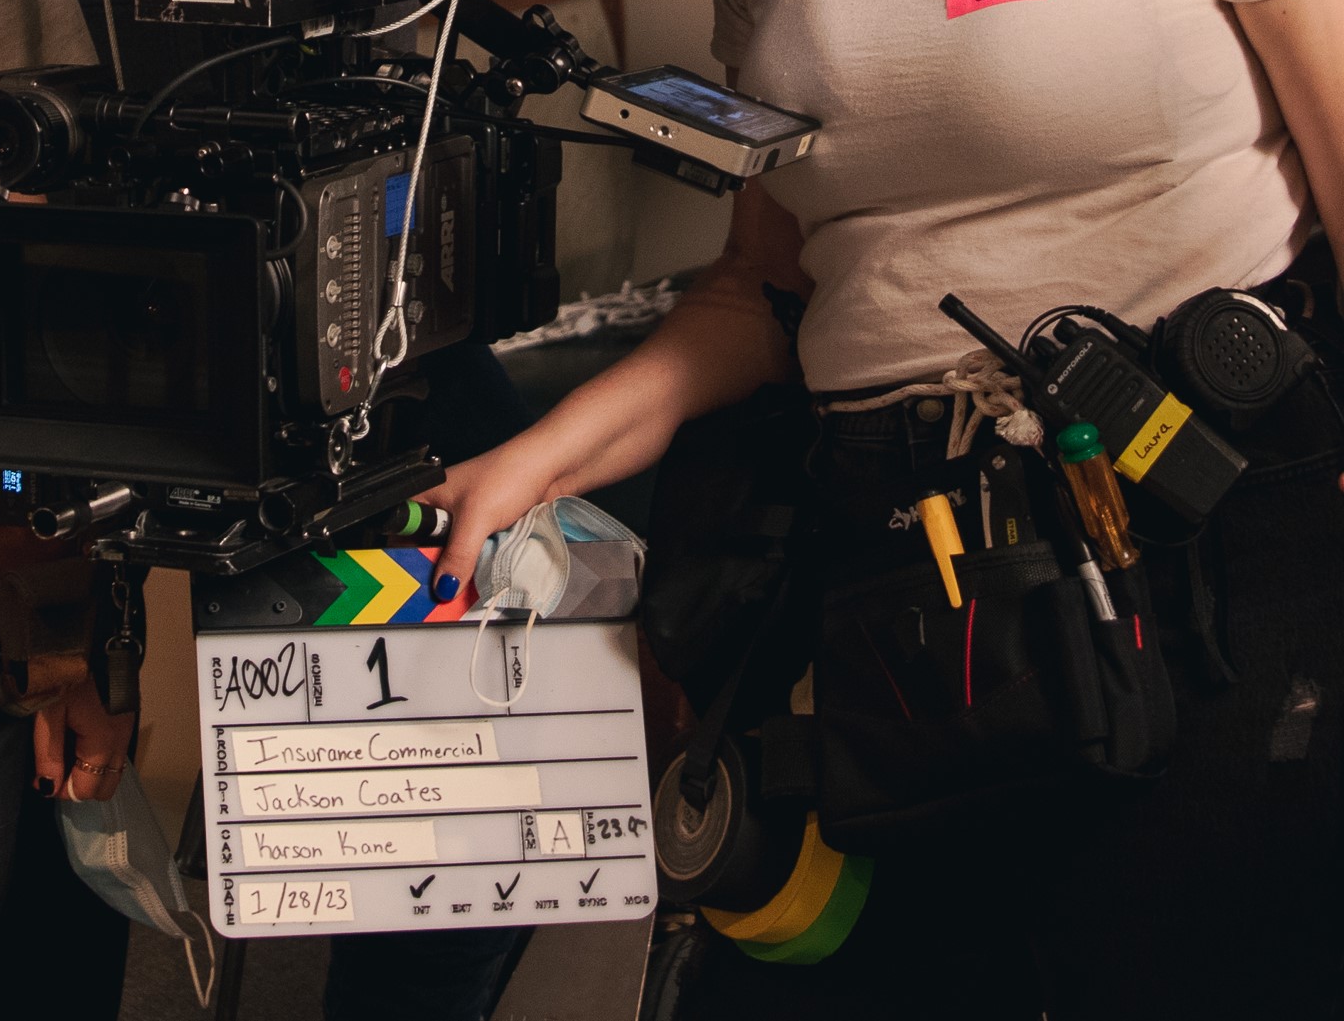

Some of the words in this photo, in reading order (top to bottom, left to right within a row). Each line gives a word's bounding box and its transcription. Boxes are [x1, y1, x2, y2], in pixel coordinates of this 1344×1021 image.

[440, 210, 455, 293] ARRI
[1057, 341, 1093, 384] MOTOROLA
[1134, 423, 1173, 460] Laura
[1008, 519, 1016, 543] STANL
[212, 657, 223, 700] ROLL
[218, 641, 305, 712] A002
[311, 653, 323, 707] SCENE
[366, 636, 409, 711] 1
[511, 646, 523, 689] TAKE
[216, 728, 228, 772] PROD
[246, 735, 364, 766] Insurance
[368, 732, 483, 761] Commercial
[218, 781, 229, 815] DIR
[253, 783, 344, 812] Jackson
[358, 779, 443, 807] Coates
[221, 829, 233, 864] CAM
[255, 832, 323, 860] Karson
[338, 830, 398, 856] Kane
[524, 815, 536, 849] CAM
[550, 819, 571, 853] A
[223, 879, 235, 926] DATE
[413, 905, 431, 915] INT
[451, 903, 472, 914] EXT
[493, 901, 514, 912] DAY
[535, 899, 560, 910] NITE
[578, 897, 608, 908] SYNC
[624, 895, 650, 906] MOS
